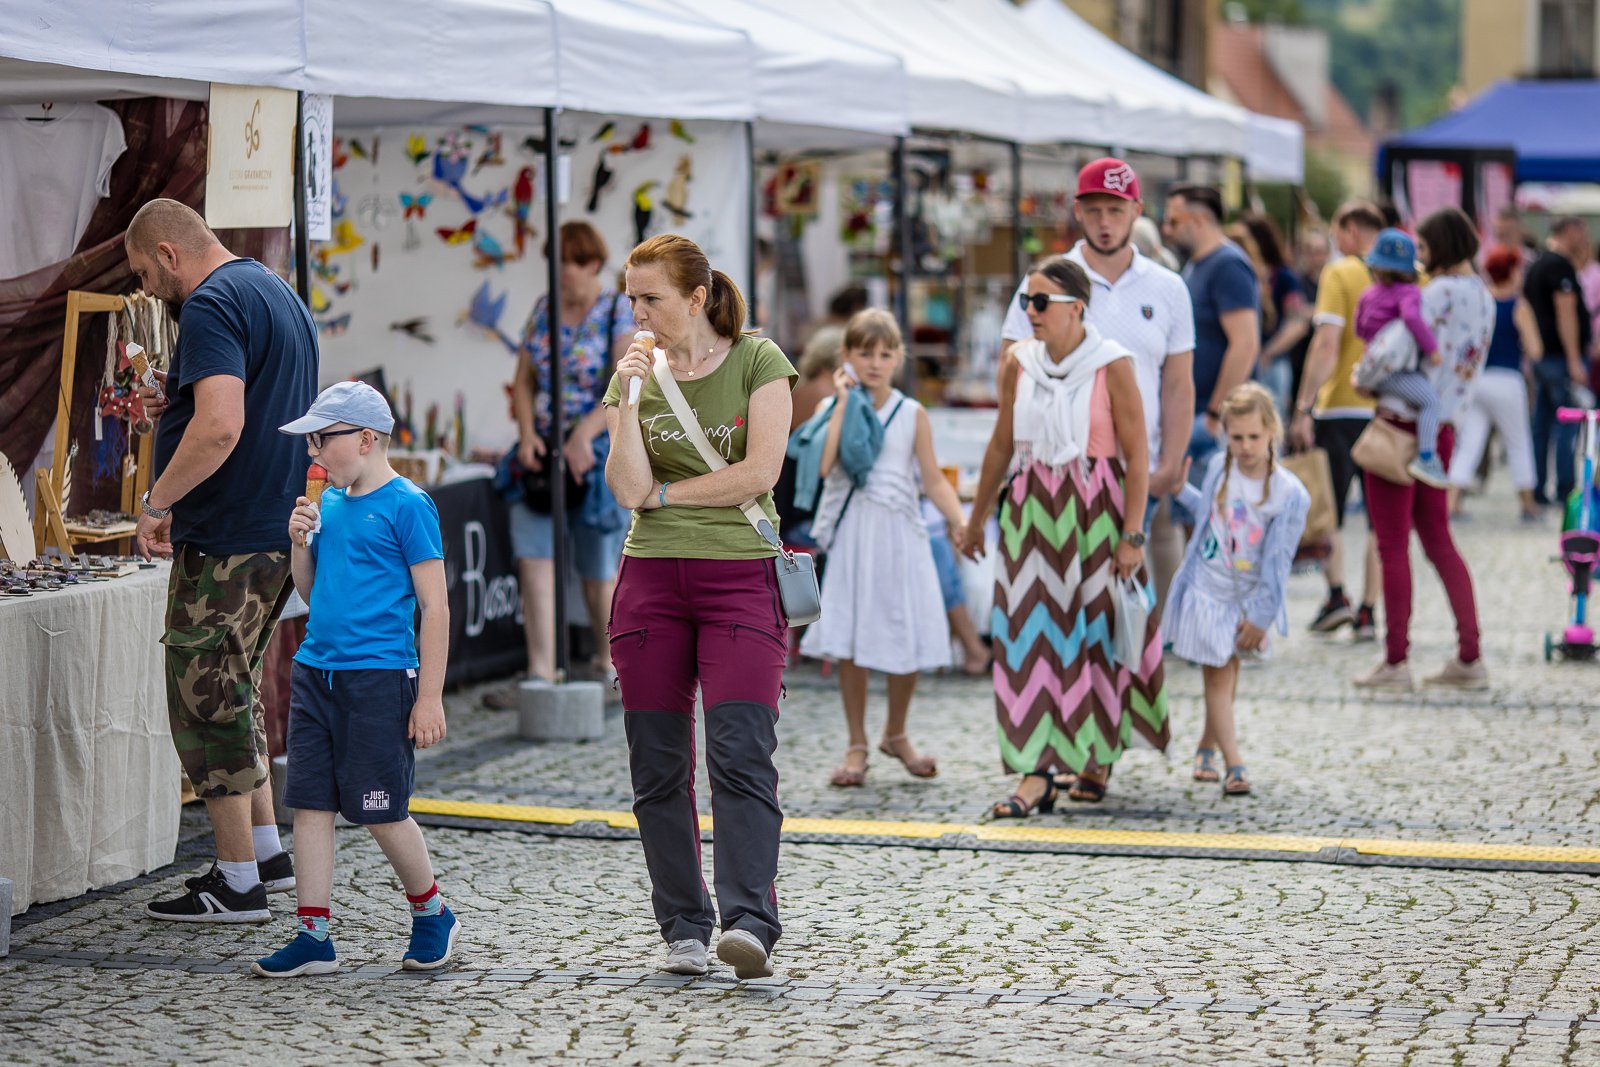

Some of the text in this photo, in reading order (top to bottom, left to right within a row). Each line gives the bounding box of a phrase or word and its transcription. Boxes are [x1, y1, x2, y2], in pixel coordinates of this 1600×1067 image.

[641, 408, 738, 460] Feeng
[369, 790, 385, 800] JUST
[364, 799, 388, 809] CHILLIN
